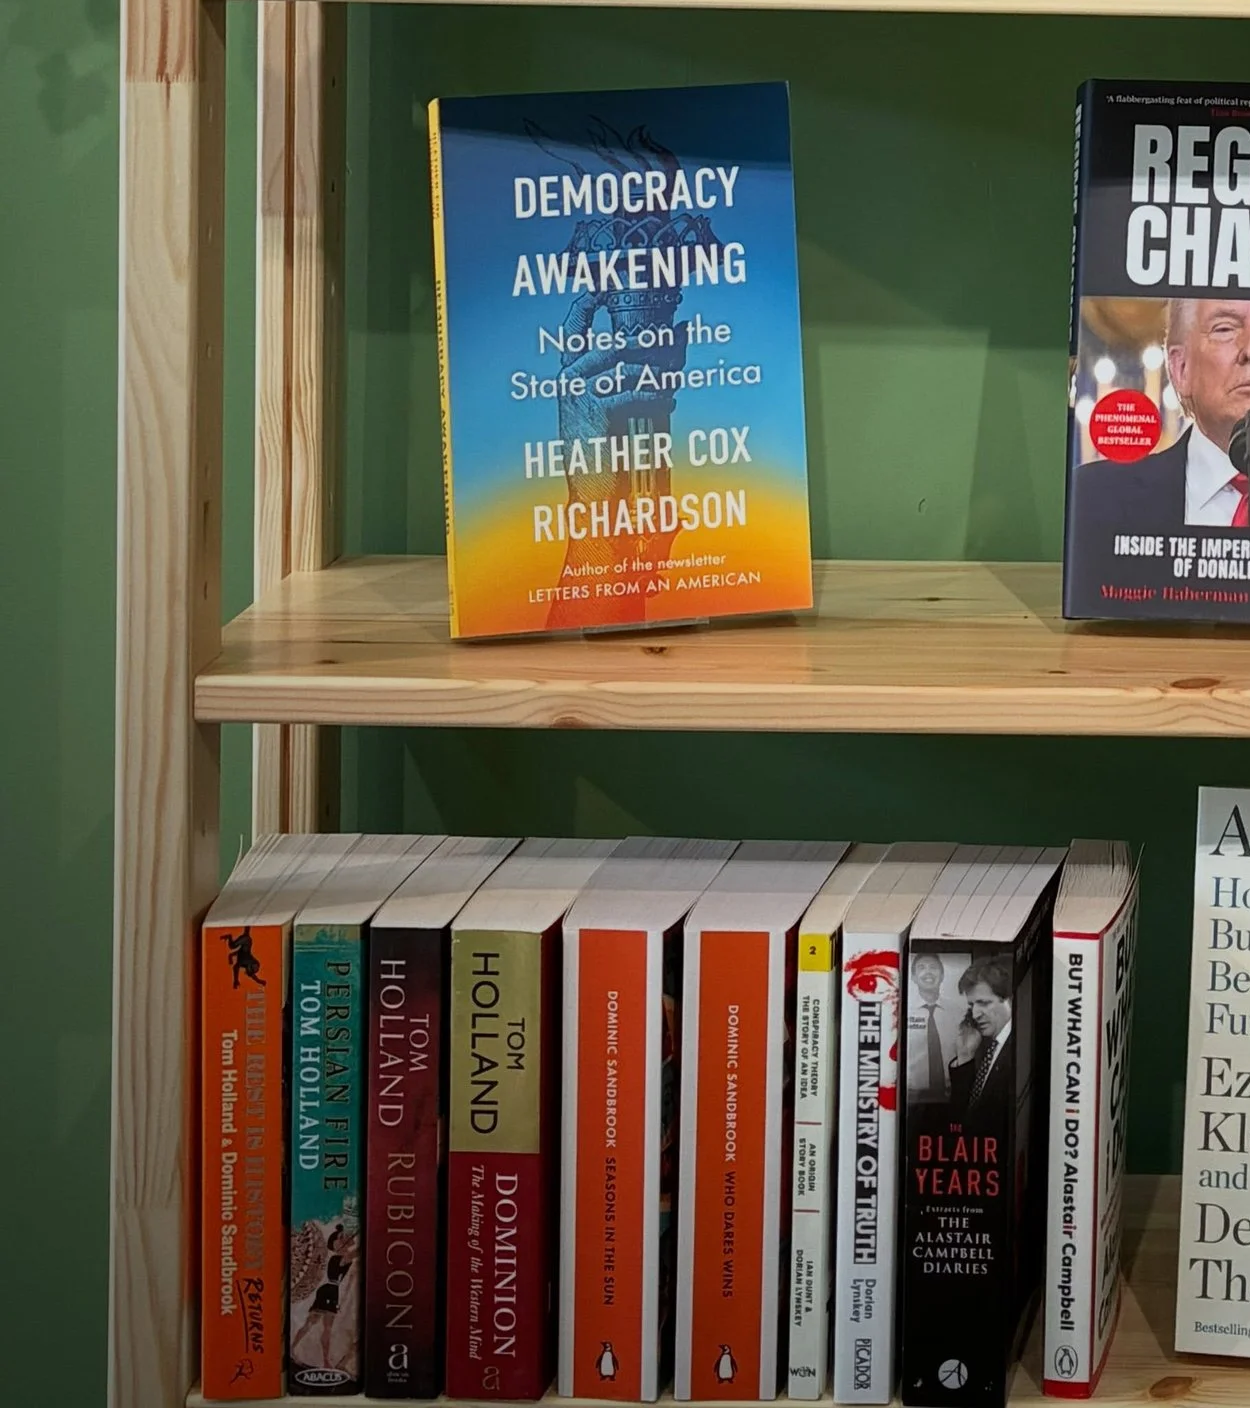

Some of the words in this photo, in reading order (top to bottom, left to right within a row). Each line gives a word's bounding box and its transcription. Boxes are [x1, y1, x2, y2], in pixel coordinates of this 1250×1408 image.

[514, 166, 739, 219] DEMOCRACY
[512, 242, 747, 297] AWAKENING
[538, 325, 627, 354] Notes
[638, 328, 674, 349] on
[687, 314, 731, 344] the
[510, 371, 586, 400] State
[596, 361, 625, 395] of
[636, 358, 762, 391] America
[1095, 414, 1156, 423] PHENOMENAL
[1107, 425, 1143, 434] GLOBAL
[1117, 403, 1136, 411] THE
[524, 432, 674, 479] HEATHER
[689, 426, 752, 467] COX
[1097, 436, 1152, 445] BESTSELLER
[534, 489, 747, 542] RICHARDSON
[562, 560, 609, 578] Author
[614, 558, 628, 574] of
[632, 556, 653, 572] the
[657, 553, 727, 569] newsletter
[1114, 535, 1164, 557] INSIDE
[1169, 537, 1197, 558] THE
[1174, 558, 1193, 578] OF
[528, 585, 589, 604] LETTERS
[596, 582, 640, 598] FROM
[646, 578, 670, 593] AN
[676, 572, 762, 591] AMERICAN
[1068, 953, 1083, 994] BUT
[324, 960, 351, 1103] PERSIAN
[378, 960, 406, 1126] HOLLAND
[470, 952, 500, 1134] HOLLAND
[607, 991, 618, 1055] DOMINIC
[859, 1001, 882, 1051] THE
[1066, 997, 1082, 1058] WHAT
[606, 1059, 618, 1148] SANDBROOK
[856, 1052, 881, 1148] MINISTRY
[1065, 1062, 1081, 1106] CAN
[323, 1118, 349, 1190] FIRE
[919, 1135, 998, 1163] BLAIR
[1063, 1119, 1080, 1159] DO?
[604, 1156, 616, 1223] SEASONS
[856, 1156, 878, 1189] OF
[915, 1168, 999, 1197] YEARS
[1062, 1163, 1078, 1240] Alastair
[385, 1153, 416, 1330] RUBICON
[604, 1226, 616, 1241] IN
[855, 1195, 877, 1264] TRUTH
[492, 1173, 518, 1358] DOMINION
[603, 1246, 615, 1271] THE
[603, 1276, 615, 1306] SUN
[1057, 1242, 1077, 1332] Campbell
